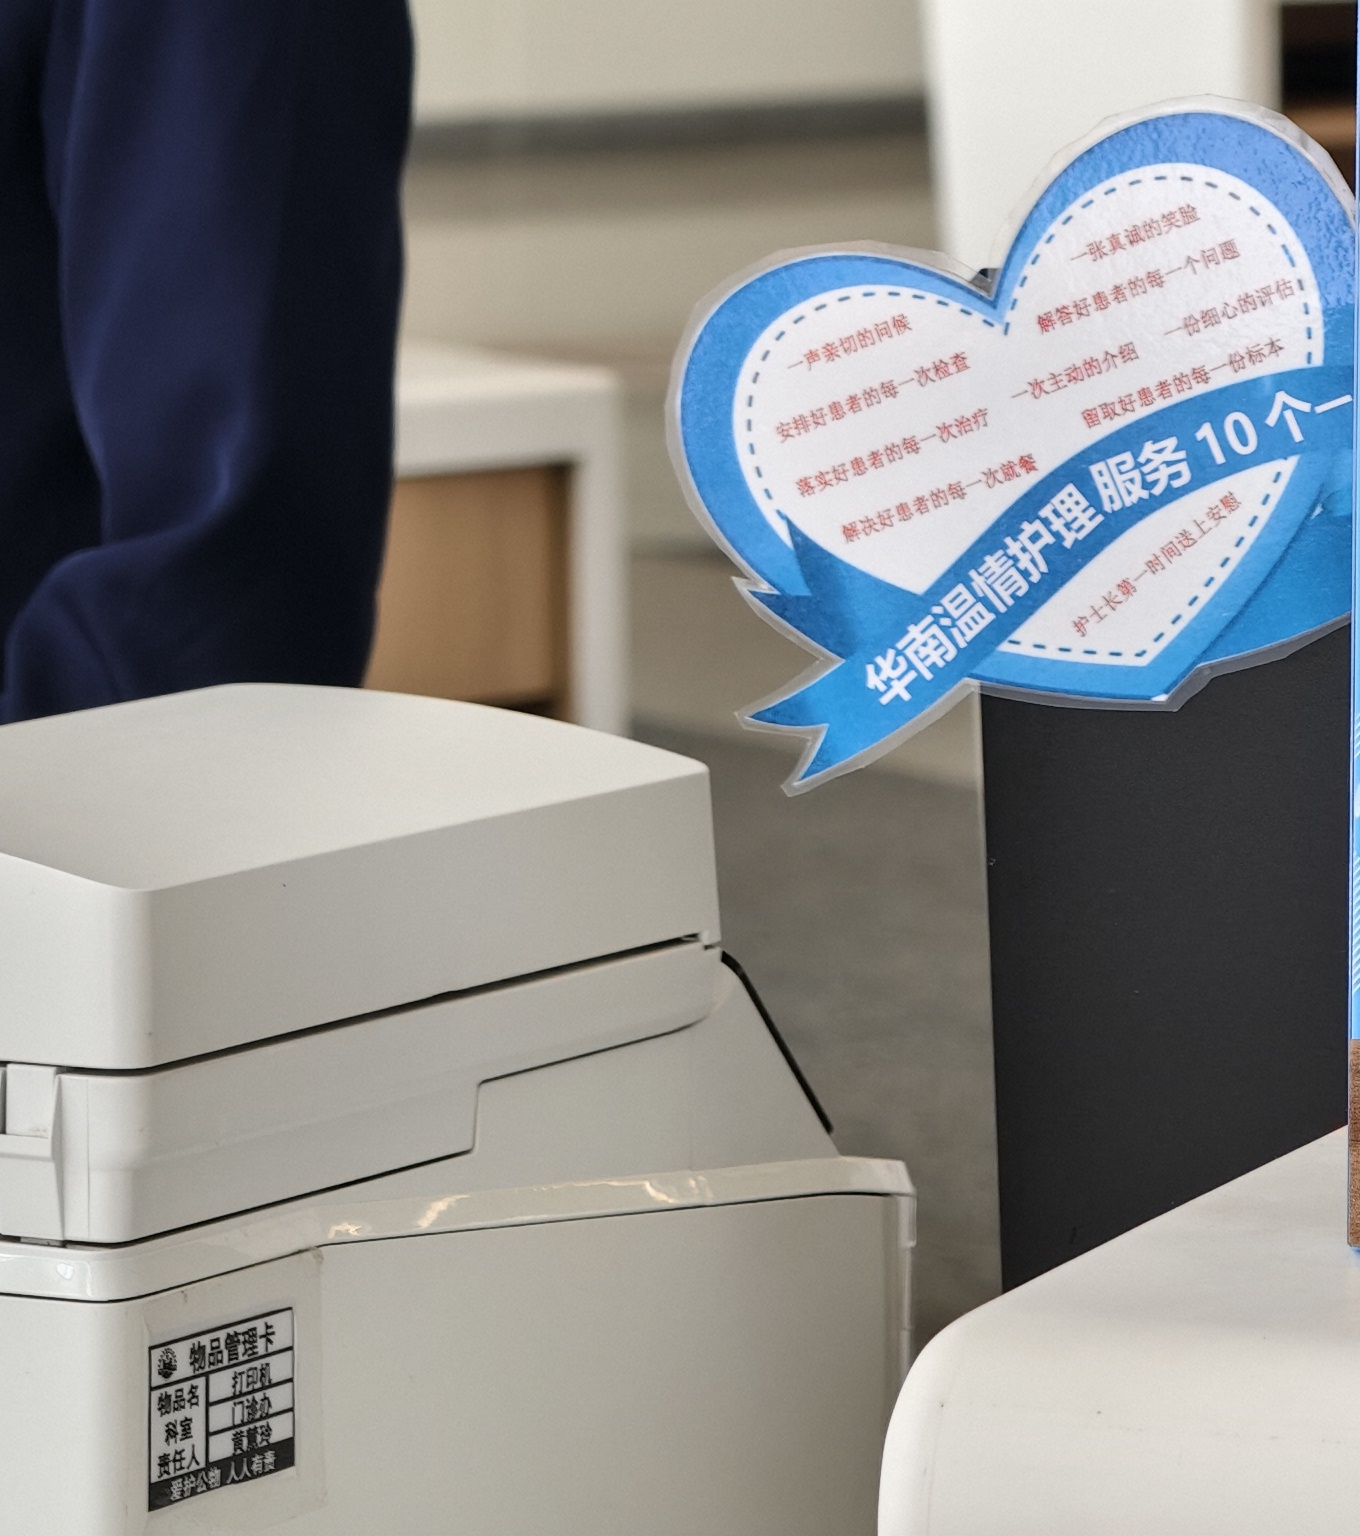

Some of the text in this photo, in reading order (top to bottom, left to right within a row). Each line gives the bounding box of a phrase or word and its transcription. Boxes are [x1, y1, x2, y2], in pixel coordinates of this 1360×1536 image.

[1070, 203, 1201, 262] 一张真诚的笑脸
[1036, 238, 1241, 334] 解答好患者的每一个问题
[1164, 278, 1295, 337] 一份细心的评估
[787, 313, 913, 371] 一声亲切的问候
[1011, 341, 1140, 400] 一次主动的介绍
[776, 351, 971, 443] 安排好患者的每一次检查
[1081, 336, 1285, 429] 留取好患者的每一份标本
[795, 408, 989, 498] 落实好患者的每一次治疗
[840, 453, 1039, 543] 解决好患者的每一次就餐
[1073, 491, 1241, 637] 护士长第一时间送上安慰
[189, 1321, 276, 1374] 物品管理卡
[157, 1384, 200, 1417] 物品名
[165, 1416, 194, 1446] 科室
[157, 1444, 200, 1479] 责任人
